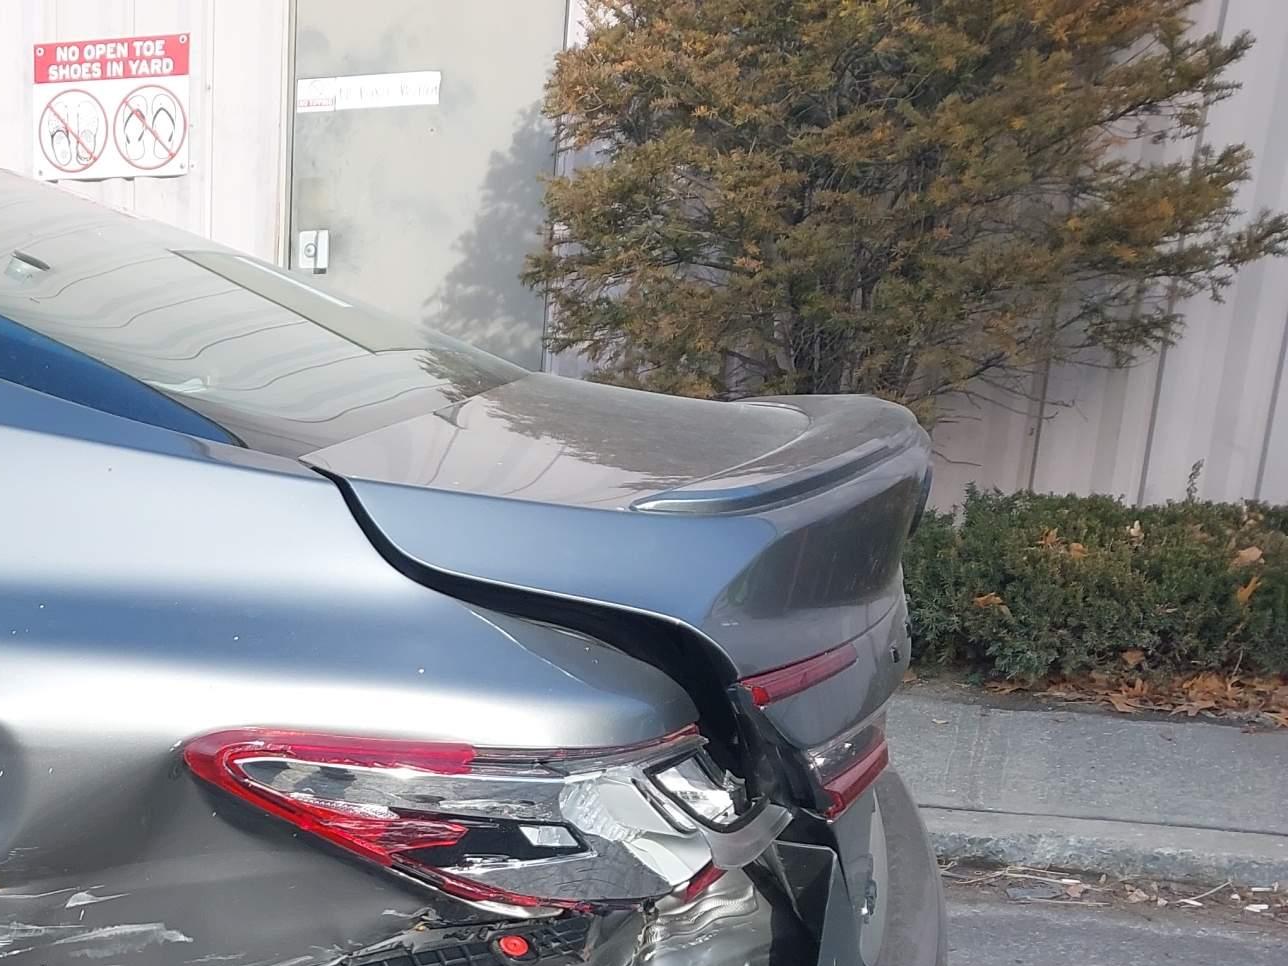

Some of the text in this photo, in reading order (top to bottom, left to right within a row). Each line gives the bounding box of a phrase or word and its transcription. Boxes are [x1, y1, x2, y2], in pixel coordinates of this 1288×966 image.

[56, 39, 165, 62] NO OPEN TOE
[48, 57, 174, 81] SHOES IN YARD
